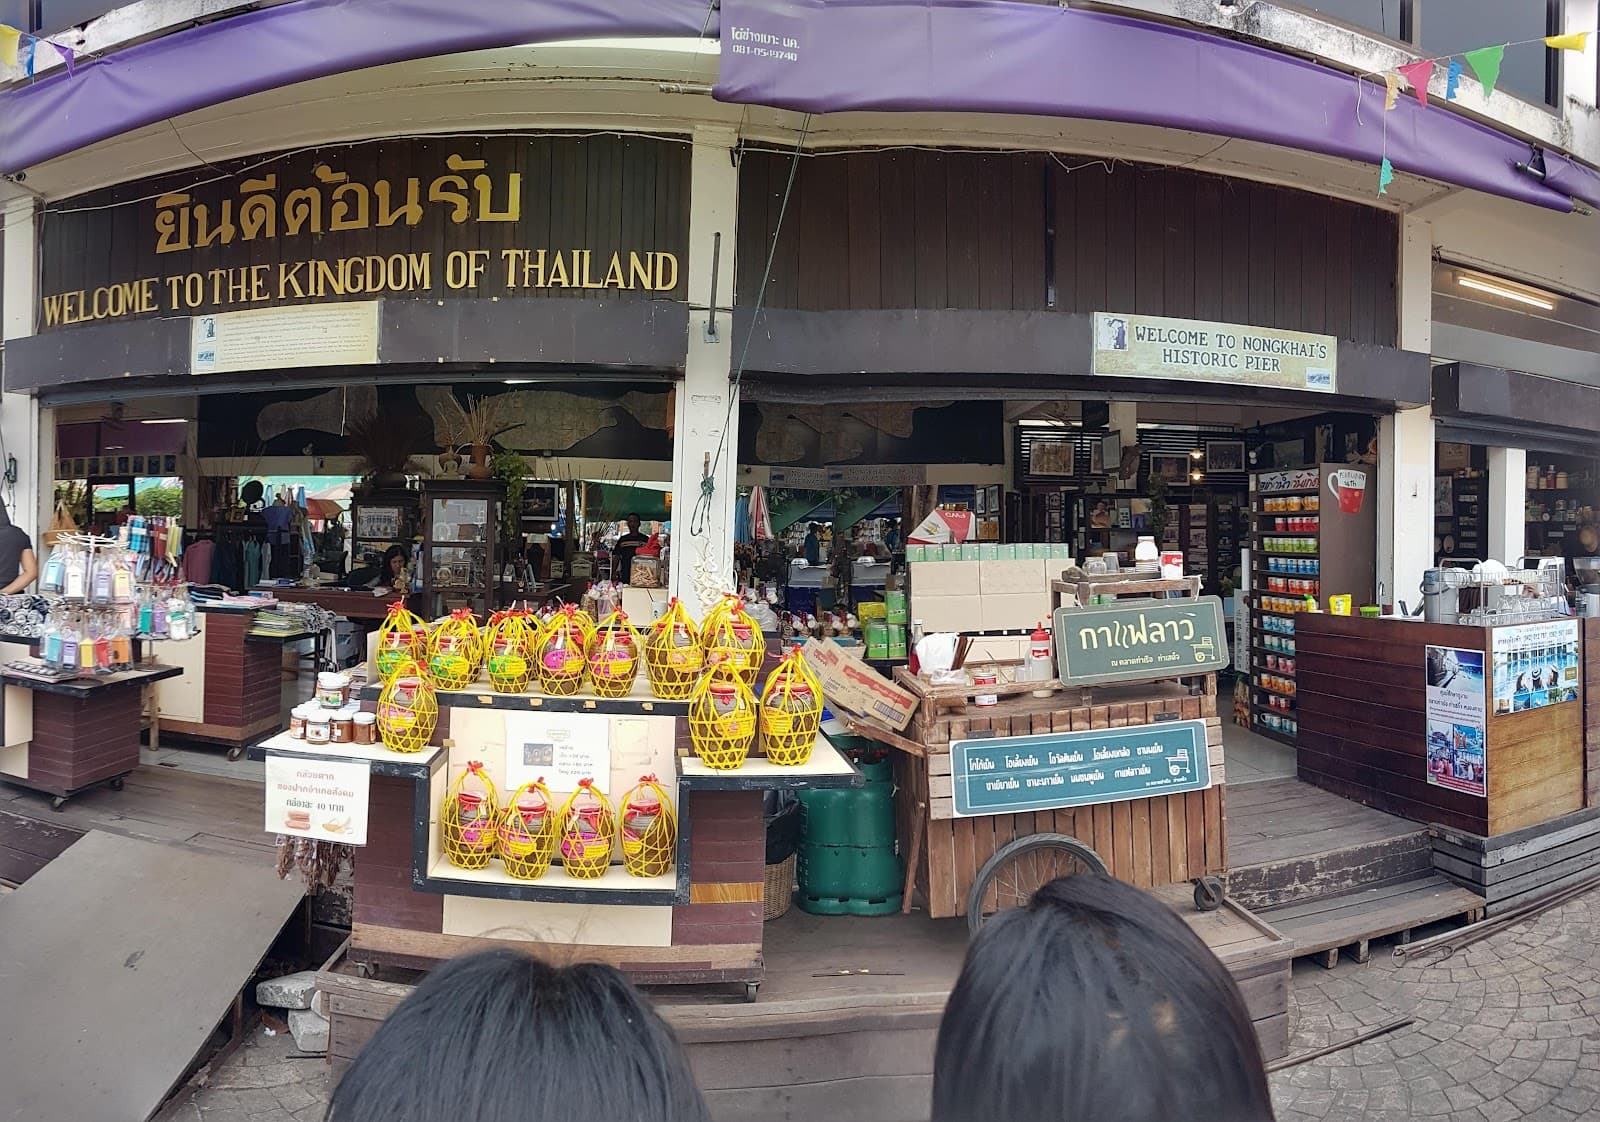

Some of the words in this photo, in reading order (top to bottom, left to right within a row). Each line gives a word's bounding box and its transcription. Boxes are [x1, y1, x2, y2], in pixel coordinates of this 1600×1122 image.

[155, 154, 522, 254] ยินดีต้อนรับ
[43, 277, 160, 327] WELCOME
[166, 272, 203, 310] TO
[208, 264, 271, 305] THE
[278, 252, 432, 299] KINGDOM
[446, 250, 490, 289] OF
[501, 249, 679, 291] THAILAND
[1135, 326, 1209, 347] WELCOME
[1216, 333, 1236, 349] TO
[1243, 336, 1327, 360] NONGKHAI'S
[1163, 348, 1238, 369] HISTORIC
[1245, 355, 1281, 372] PIER
[1079, 613, 1195, 650] กาแฟลาว
